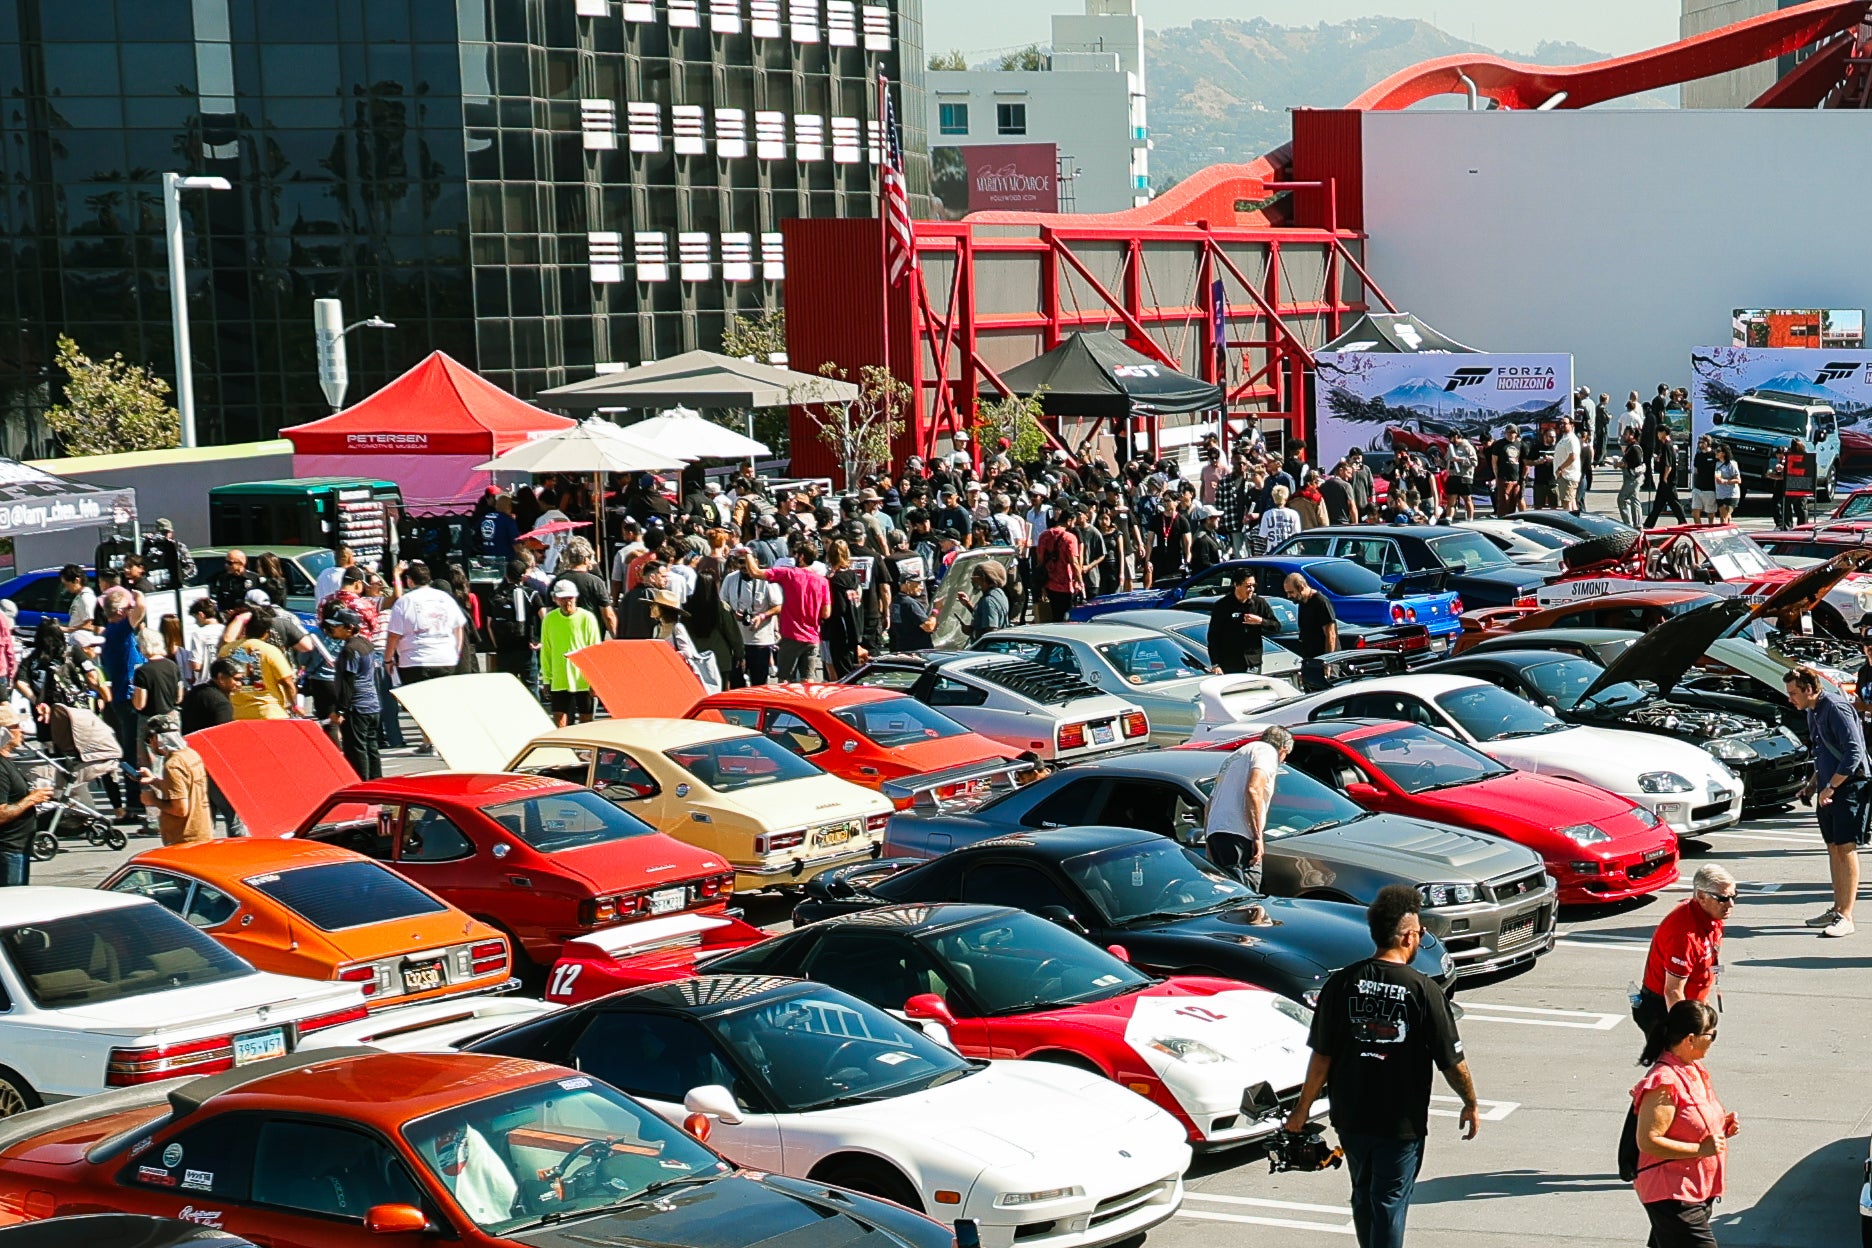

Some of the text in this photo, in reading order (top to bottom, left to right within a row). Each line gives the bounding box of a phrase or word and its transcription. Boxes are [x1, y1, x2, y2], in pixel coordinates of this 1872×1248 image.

[976, 175, 1049, 192] MARILYN MONROE
[1497, 366, 1555, 376] FORZA
[1497, 376, 1555, 390] HORIZON 6
[346, 434, 428, 443] PETERSEN
[1571, 581, 1609, 596] SIMONIZ
[550, 963, 583, 996] 12
[1357, 979, 1411, 1001] DRIFTER
[1174, 1006, 1228, 1023] 12
[1348, 996, 1410, 1024] LOLA
